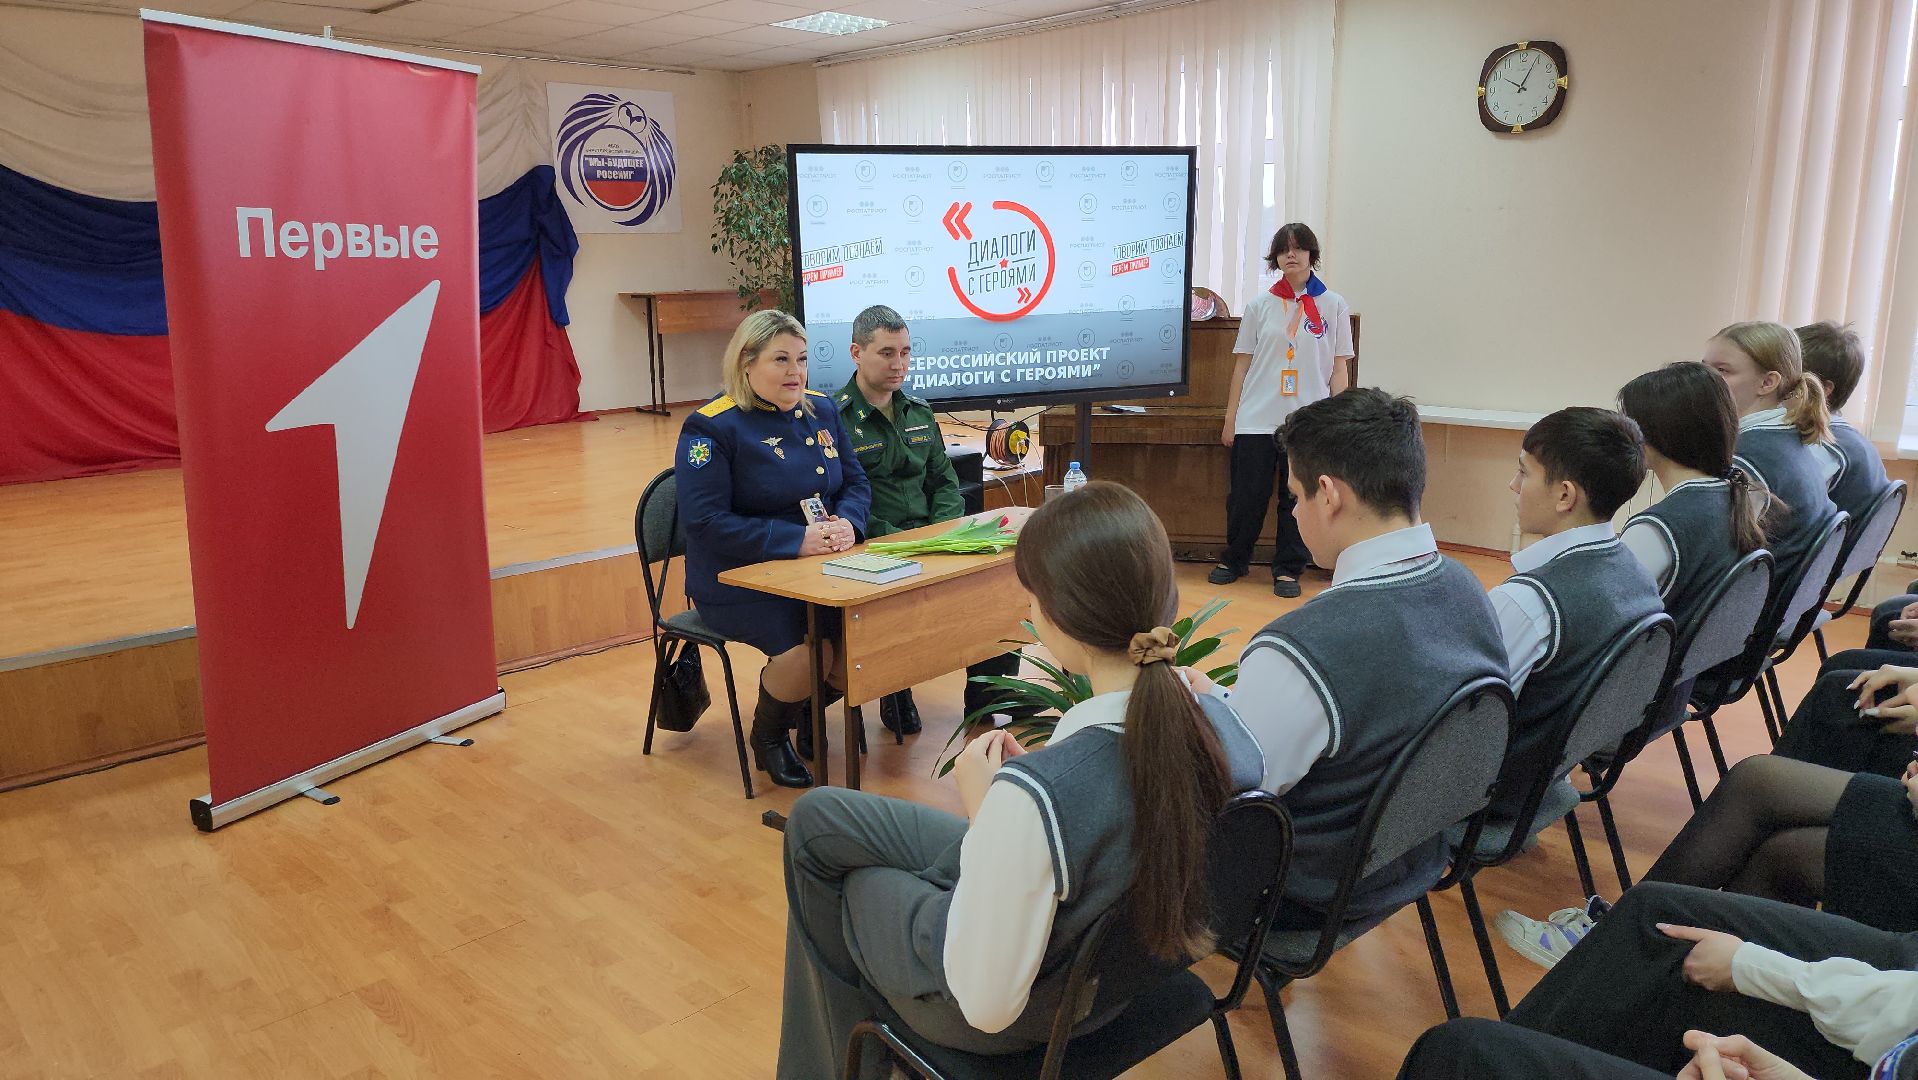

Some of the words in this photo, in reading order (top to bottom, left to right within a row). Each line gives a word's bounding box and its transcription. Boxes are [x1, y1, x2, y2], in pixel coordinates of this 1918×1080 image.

[236, 206, 439, 271] Первые
[967, 229, 1036, 269] ДИАЛОГИ
[968, 276, 975, 296] С
[979, 263, 1036, 294] ГЕРОЯМИ
[1046, 346, 1111, 364] ПРОЕКТ
[1000, 369, 1011, 382] С
